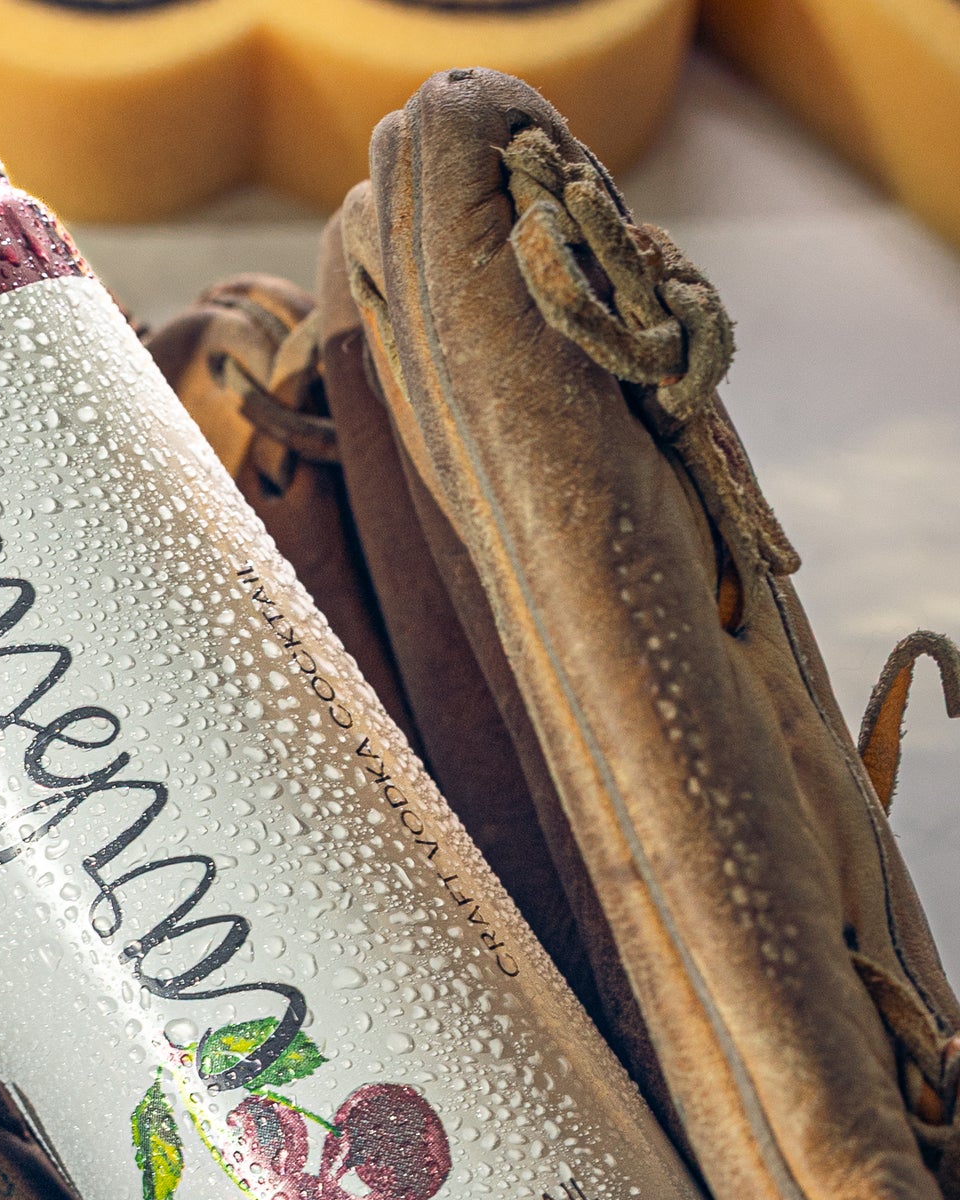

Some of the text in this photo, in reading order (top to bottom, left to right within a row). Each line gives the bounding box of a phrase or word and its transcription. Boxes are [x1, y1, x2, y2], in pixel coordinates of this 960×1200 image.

[235, 558, 520, 978] CRAFT VODKA COCKTAIL
